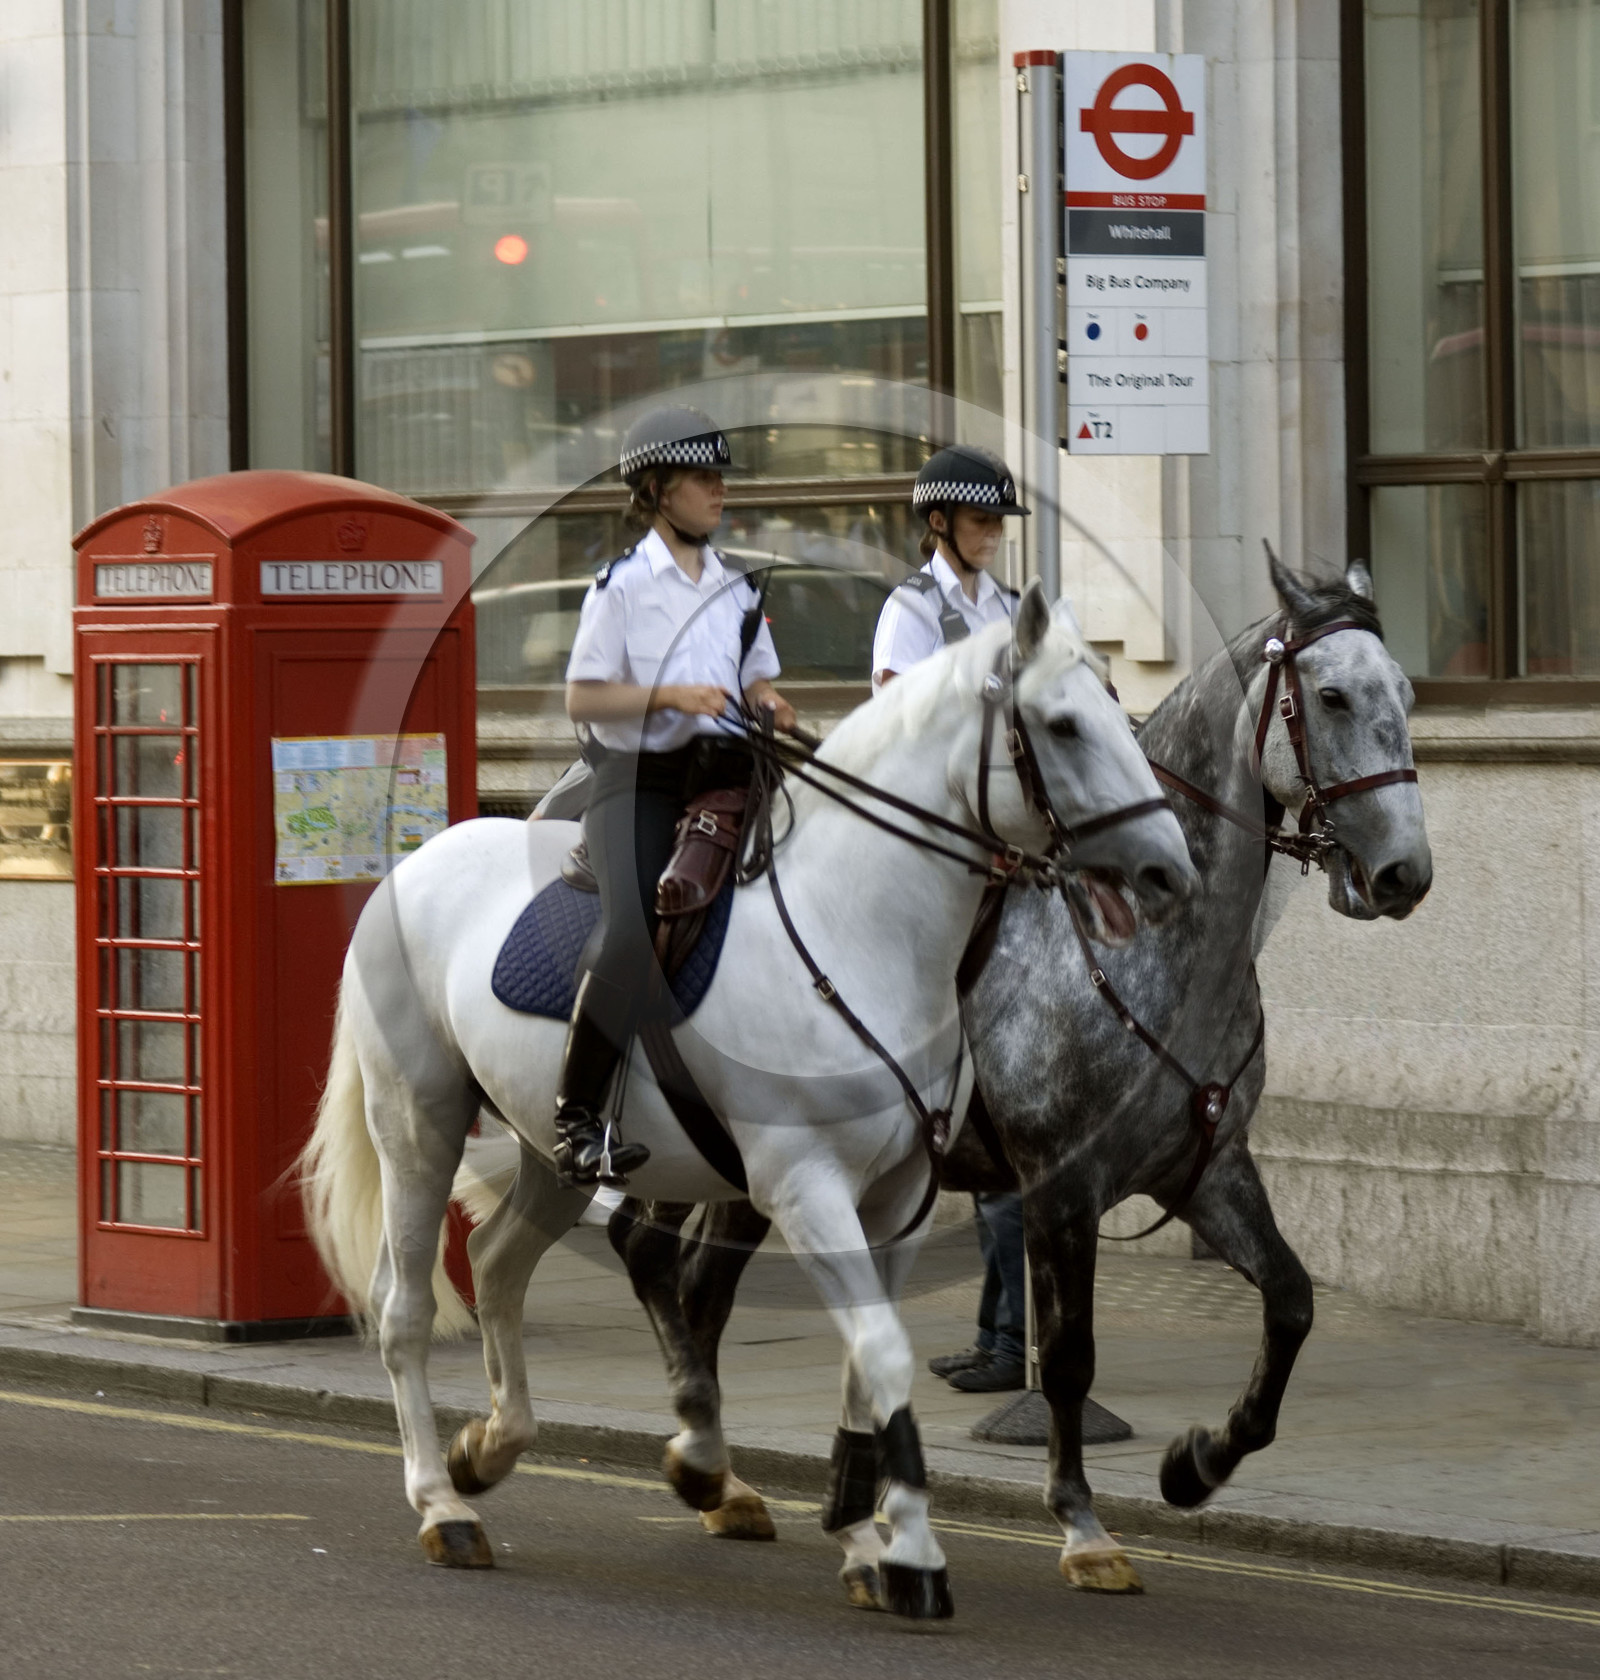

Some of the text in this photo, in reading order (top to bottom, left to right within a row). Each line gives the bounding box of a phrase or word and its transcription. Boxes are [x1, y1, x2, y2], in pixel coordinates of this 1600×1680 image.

[1112, 194, 1168, 208] BUS STOP
[1107, 224, 1172, 240] Whitehall
[1085, 275, 1191, 292] Big Bus Company
[1086, 373, 1194, 390] The Original Tour
[1091, 421, 1114, 439] T2
[100, 564, 211, 593] TELEPHONE
[267, 563, 437, 591] TELEPHONE
